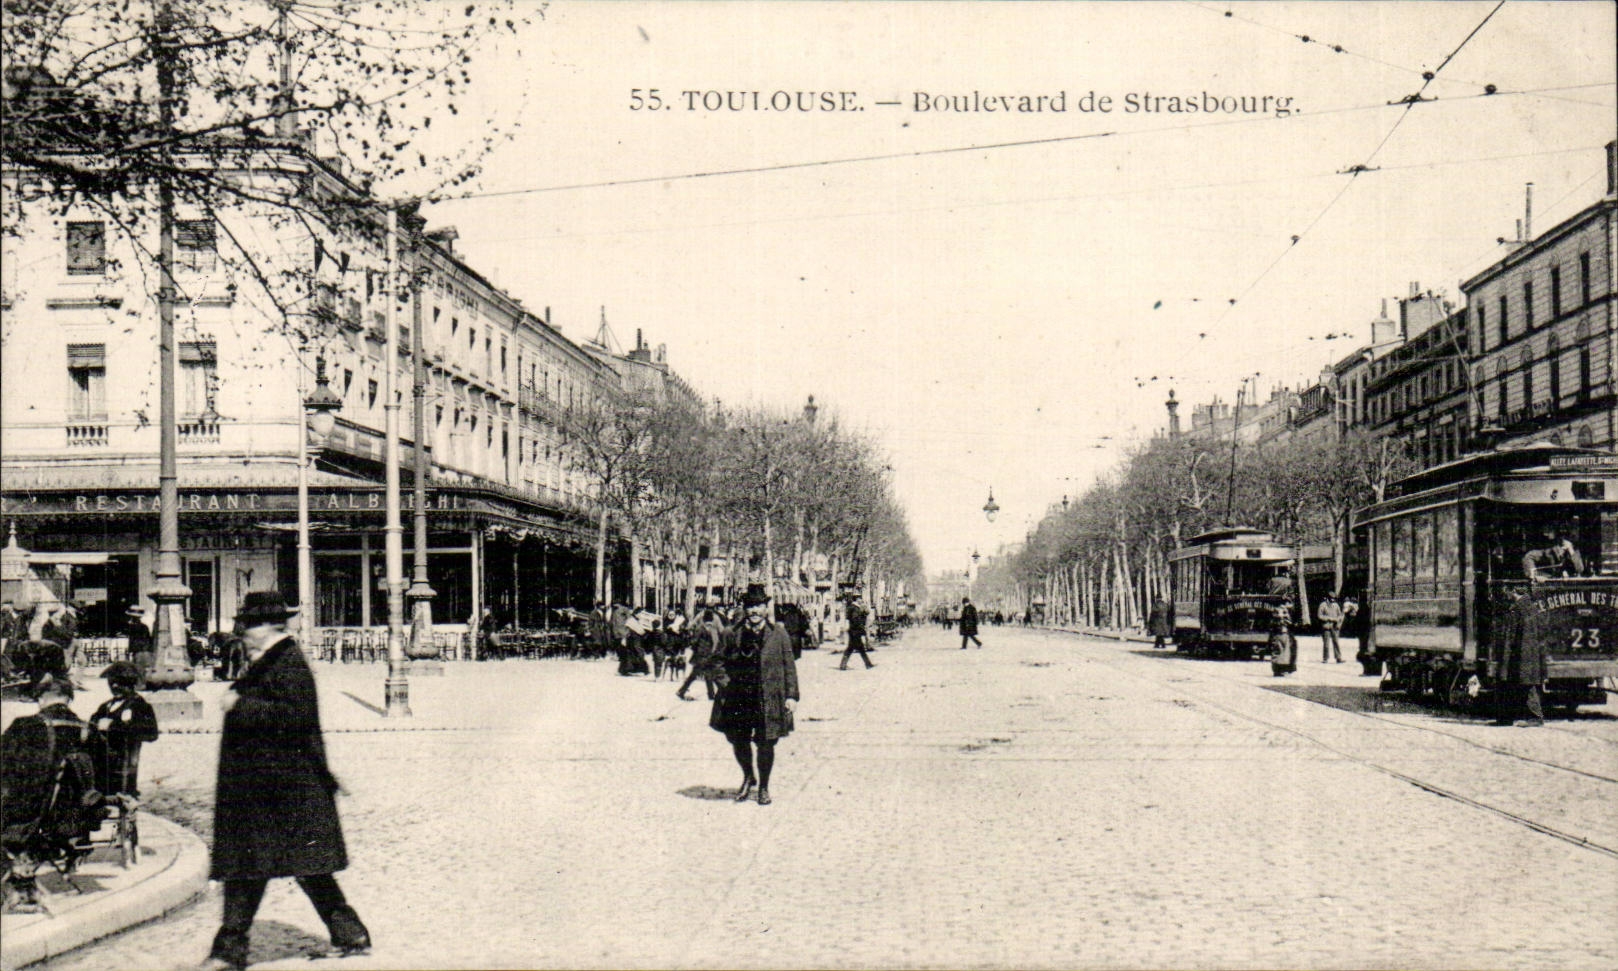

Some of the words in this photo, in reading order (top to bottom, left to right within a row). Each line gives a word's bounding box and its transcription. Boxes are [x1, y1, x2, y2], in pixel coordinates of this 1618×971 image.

[328, 494, 458, 509] ALBIGHI
[1591, 592, 1606, 605] DES
[1571, 628, 1600, 648] 23
